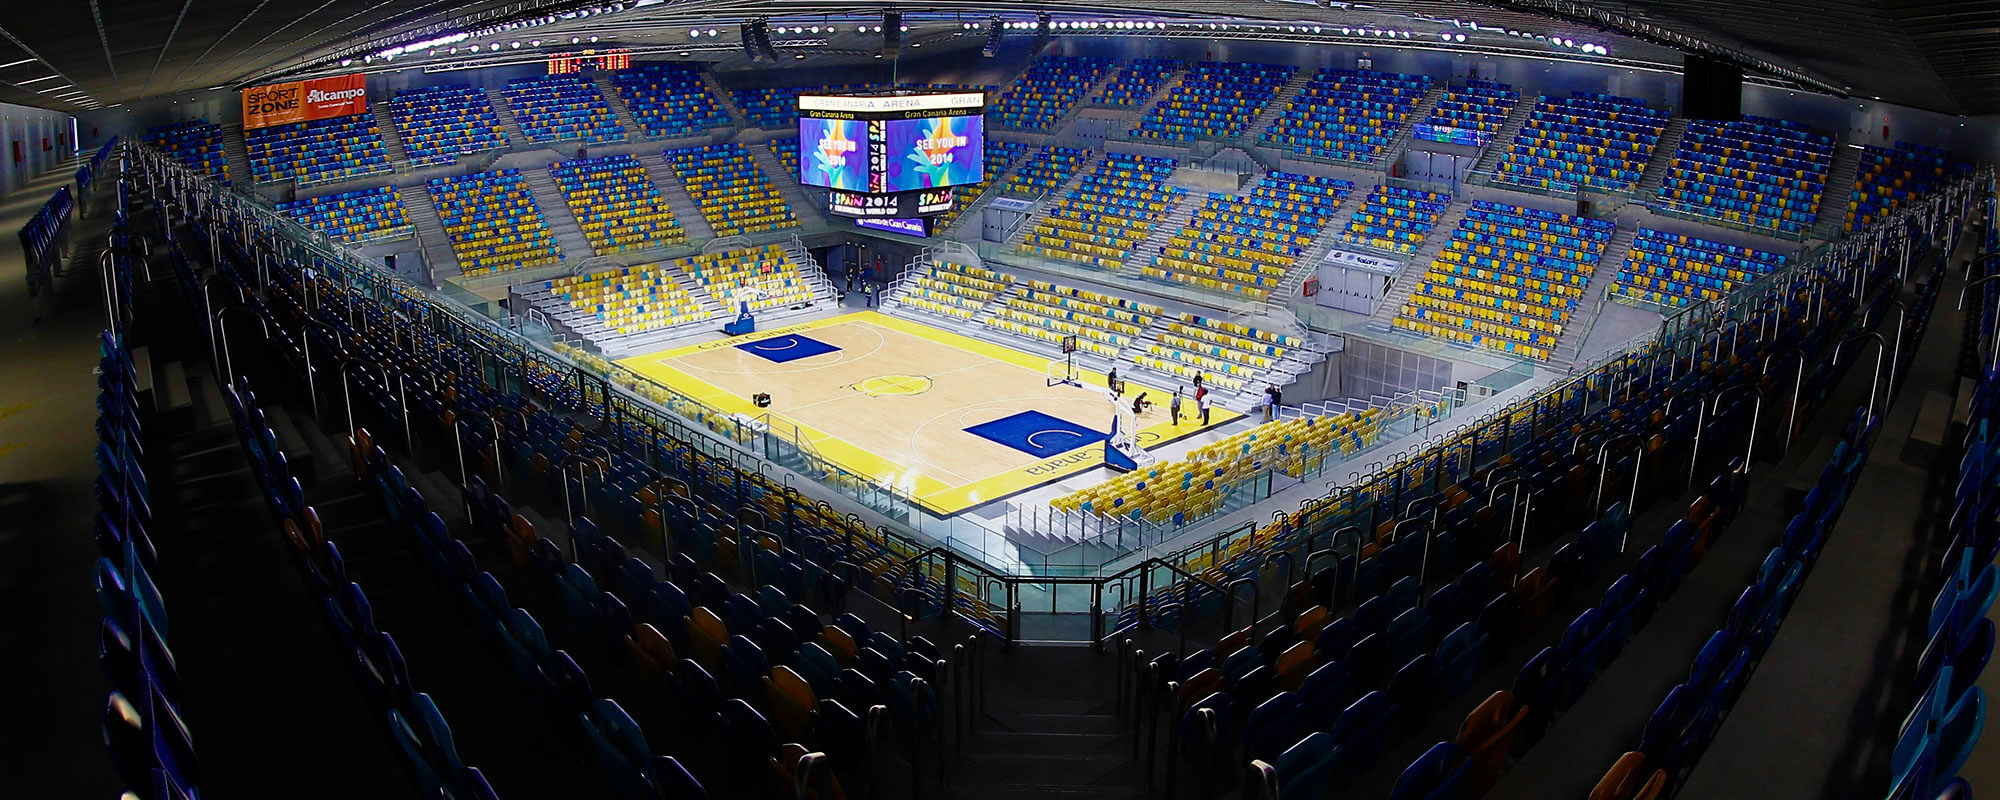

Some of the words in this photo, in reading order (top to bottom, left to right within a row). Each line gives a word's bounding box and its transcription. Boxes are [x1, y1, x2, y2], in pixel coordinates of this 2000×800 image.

[248, 88, 299, 104] SPORT
[307, 88, 365, 104] Alcampo
[951, 95, 981, 105] GRAN
[249, 98, 300, 115] ZONE
[814, 98, 836, 108] GRAN
[837, 100, 876, 109] CANARIA
[883, 99, 921, 108] ARENA
[810, 110, 821, 118] Gran
[821, 111, 840, 119] Canaria
[840, 112, 855, 120] Arena
[905, 111, 922, 119] Gran
[922, 110, 947, 118] Canaria
[948, 108, 967, 117] Arena
[819, 139, 833, 149] SEE
[833, 140, 847, 151] YOU
[848, 141, 856, 152] IN
[916, 137, 935, 150] SEE
[936, 136, 955, 149] YOU
[957, 136, 967, 147] IN
[829, 155, 846, 167] 2014
[870, 143, 879, 171] 2014
[930, 153, 953, 165] 2014
[865, 196, 898, 207] 2014
[888, 218, 902, 228] Gran
[902, 221, 923, 232] Canaria
[698, 338, 743, 350] Gran
[745, 325, 811, 341] Canaria
